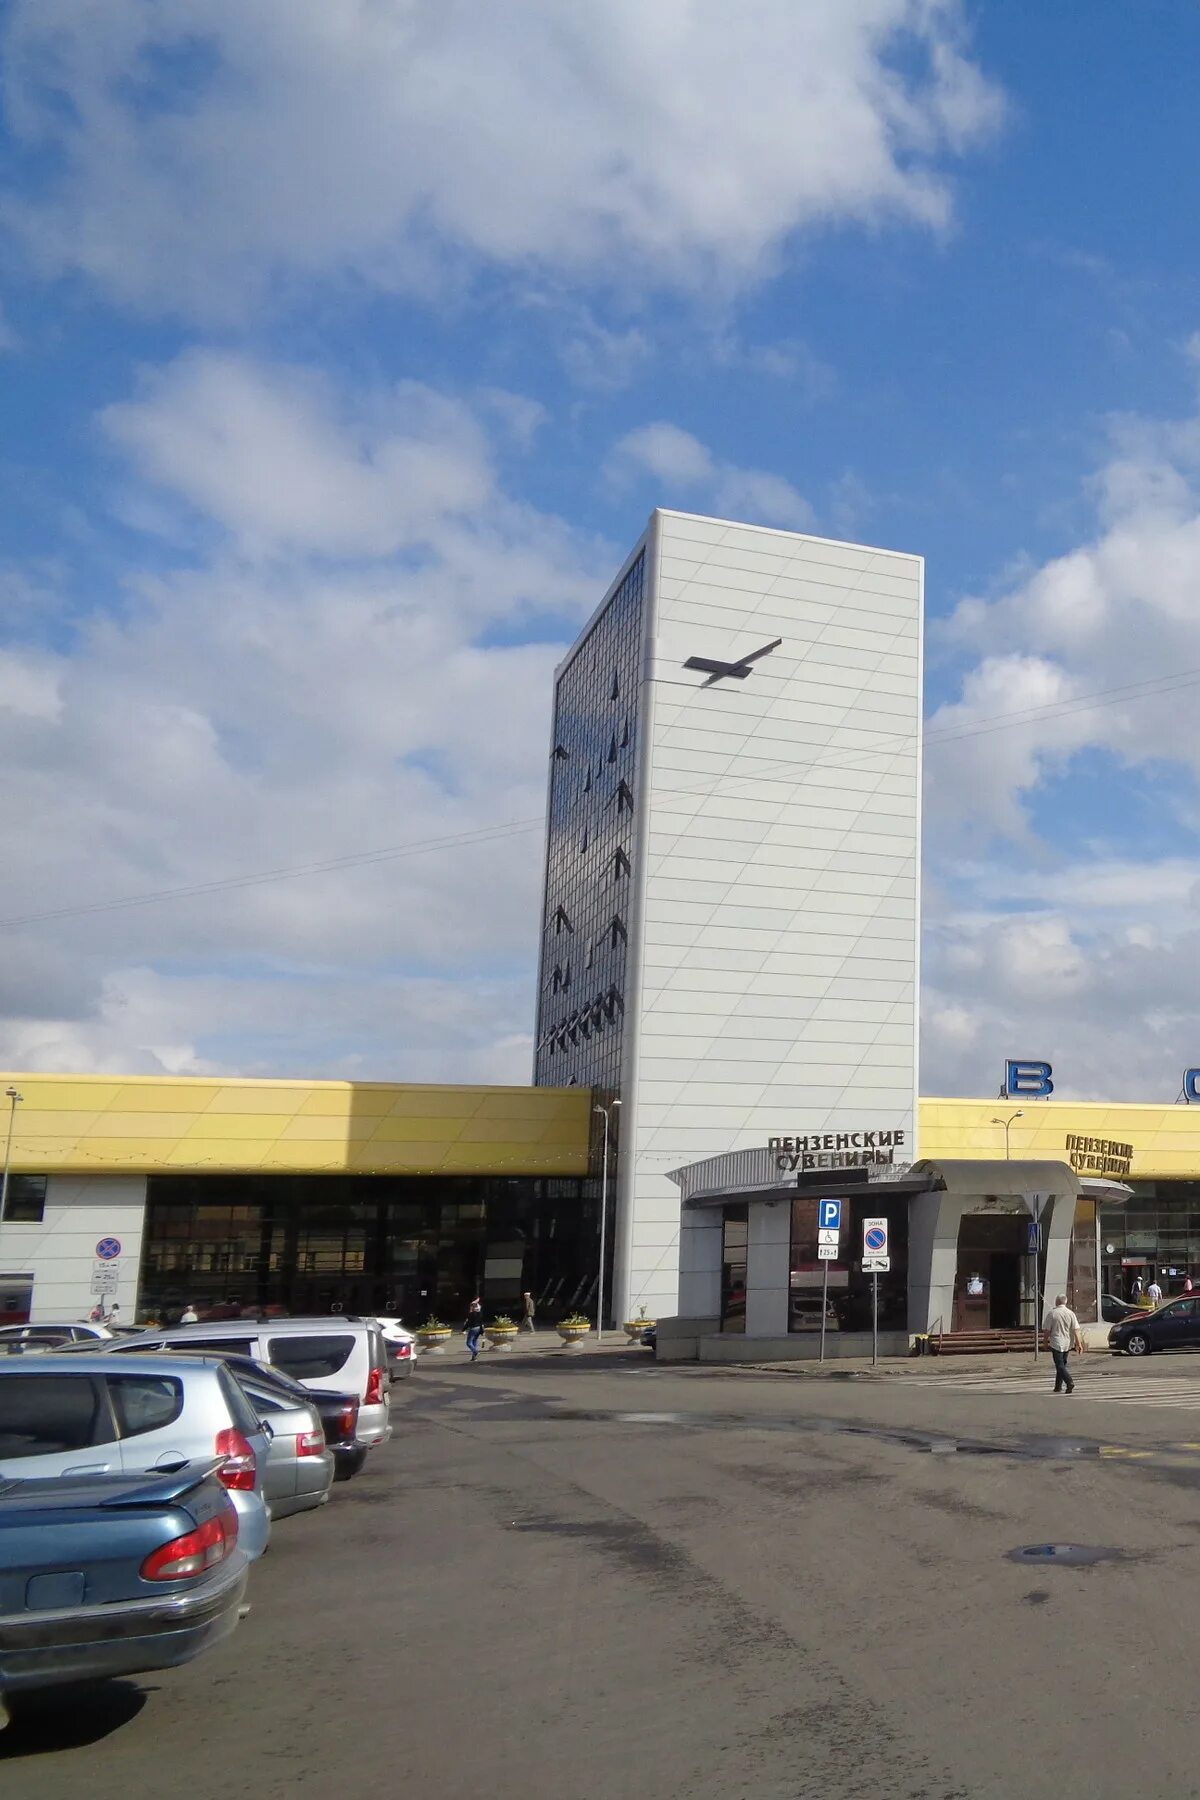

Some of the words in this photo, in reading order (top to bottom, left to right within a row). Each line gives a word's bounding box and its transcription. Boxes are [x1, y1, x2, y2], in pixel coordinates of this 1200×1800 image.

[768, 1130, 905, 1153] ПЕНЗЕНСКИЕ
[776, 1148, 894, 1172] СУВЕНИРЫ
[825, 1203, 838, 1226] P
